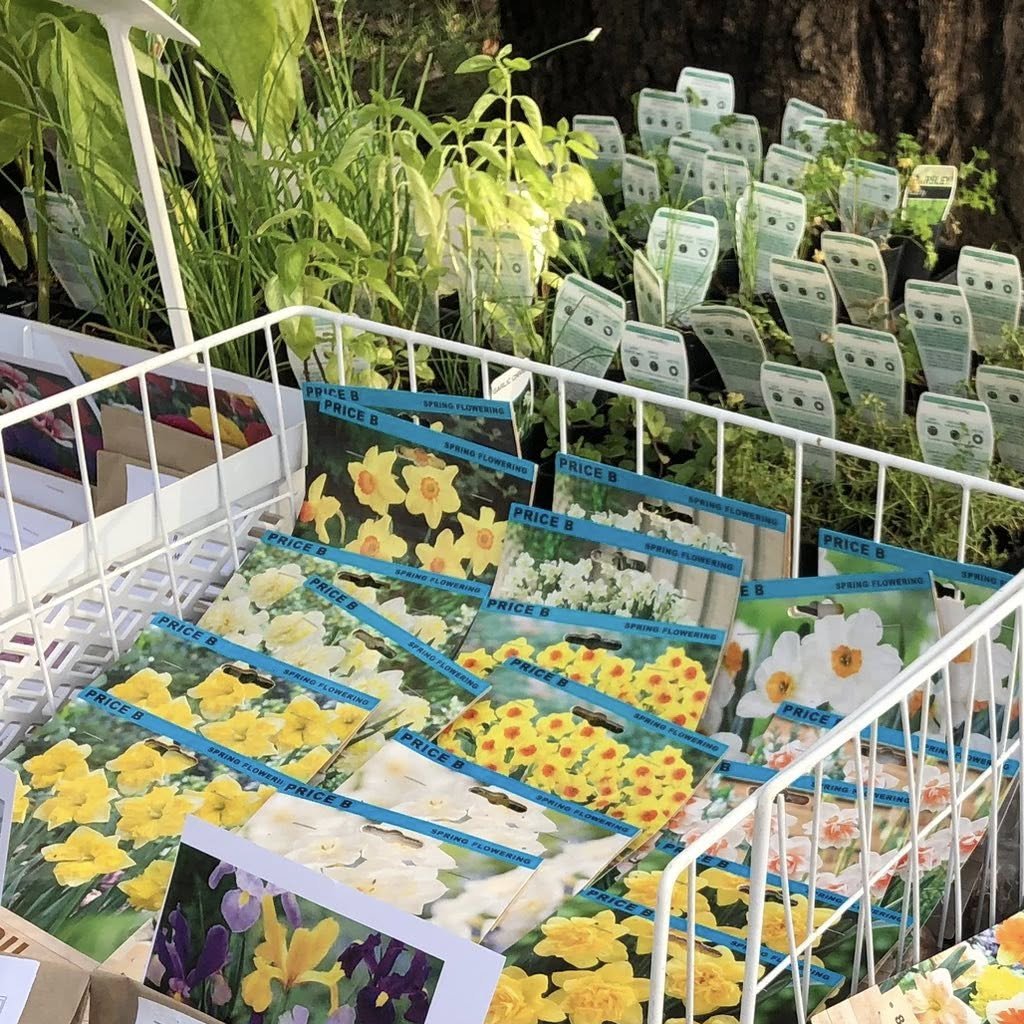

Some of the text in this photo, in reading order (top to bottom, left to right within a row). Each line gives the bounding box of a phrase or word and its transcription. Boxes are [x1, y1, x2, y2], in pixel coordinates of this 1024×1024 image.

[324, 400, 380, 426] PRICE B
[688, 496, 779, 526] SPRING FLOWERING
[824, 534, 886, 559] PRICE B
[394, 569, 481, 594] SPRING FLOWERING
[836, 576, 924, 590] SPRING FLOWERING
[487, 600, 550, 617] PRICE B
[158, 616, 218, 648] PRICE B
[284, 668, 370, 706] SPRING FLOWERING
[511, 658, 568, 688] PRICE B
[536, 794, 630, 834] SPRING FLOWERING
